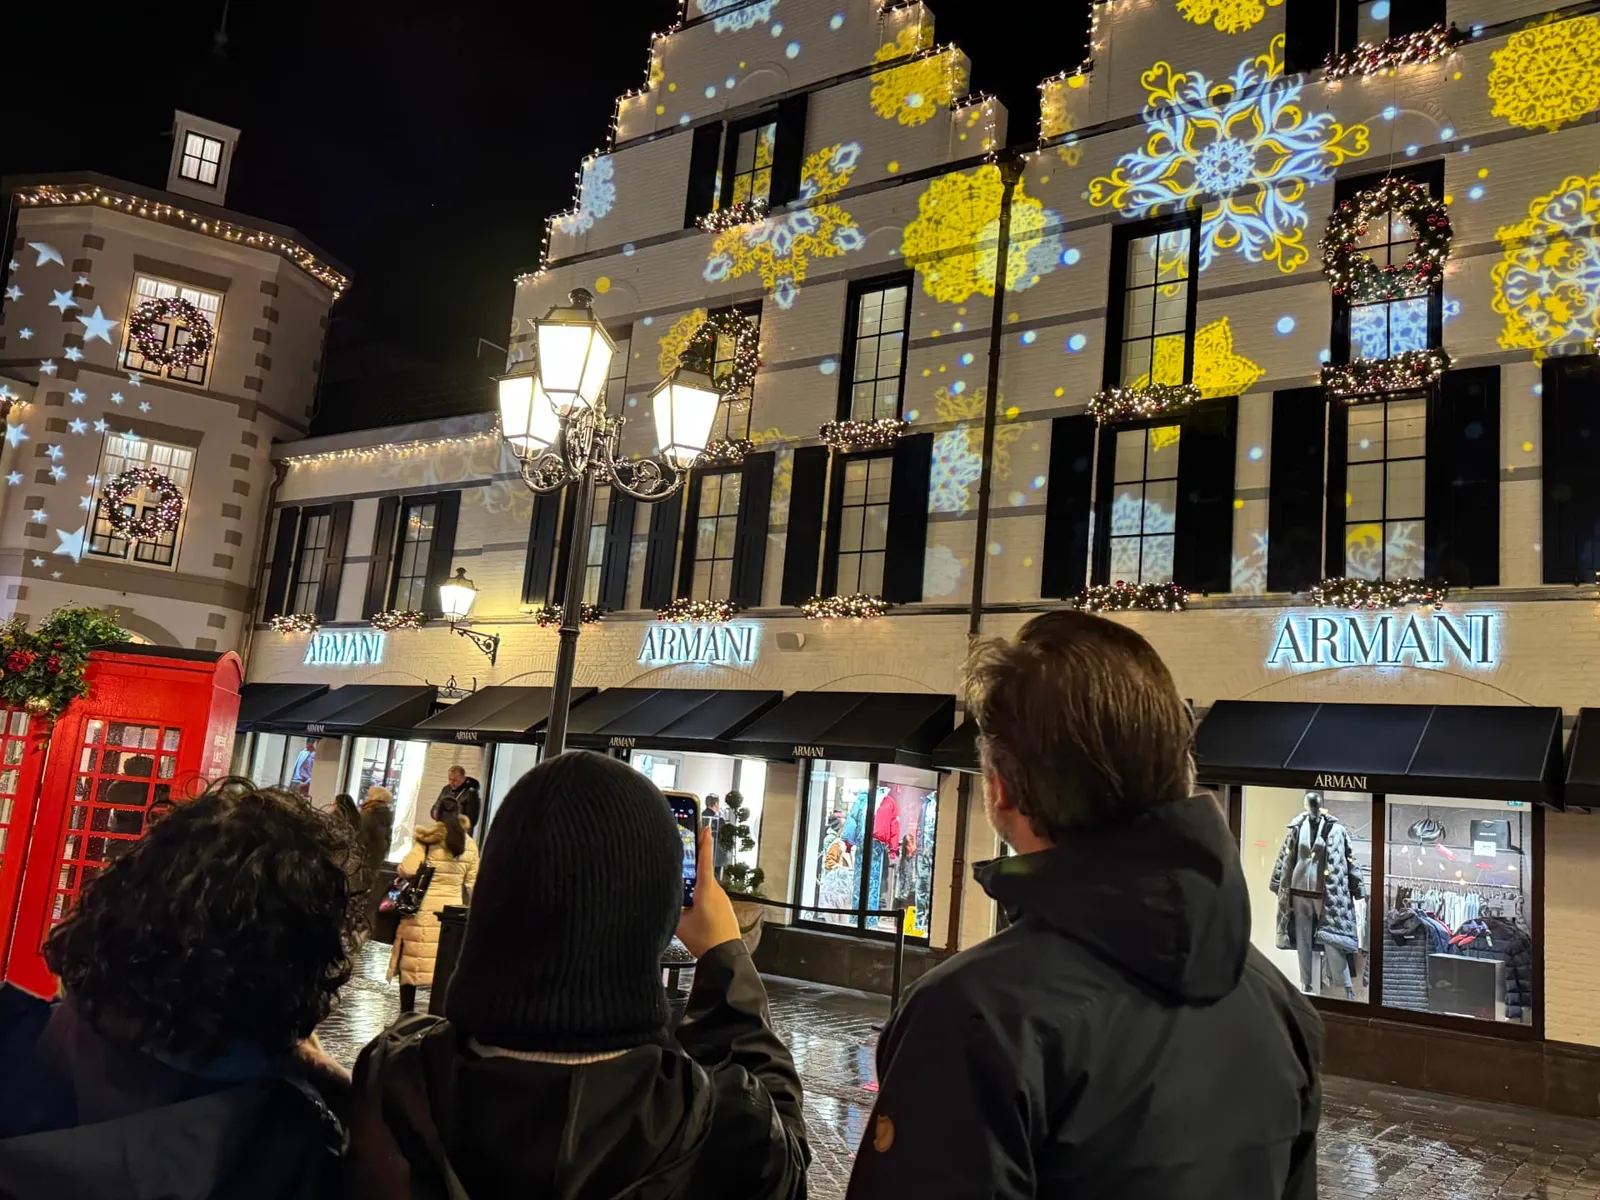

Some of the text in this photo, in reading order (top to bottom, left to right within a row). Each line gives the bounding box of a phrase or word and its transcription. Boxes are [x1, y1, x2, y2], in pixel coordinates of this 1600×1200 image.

[303, 631, 382, 663] ARMANI
[637, 625, 753, 662] ARMANI
[1268, 614, 1495, 664] ARMANI
[456, 732, 478, 740] ARMANI
[609, 737, 636, 747] ARMANI
[792, 746, 824, 757] ARMANI
[1314, 773, 1368, 789] ARMANI
